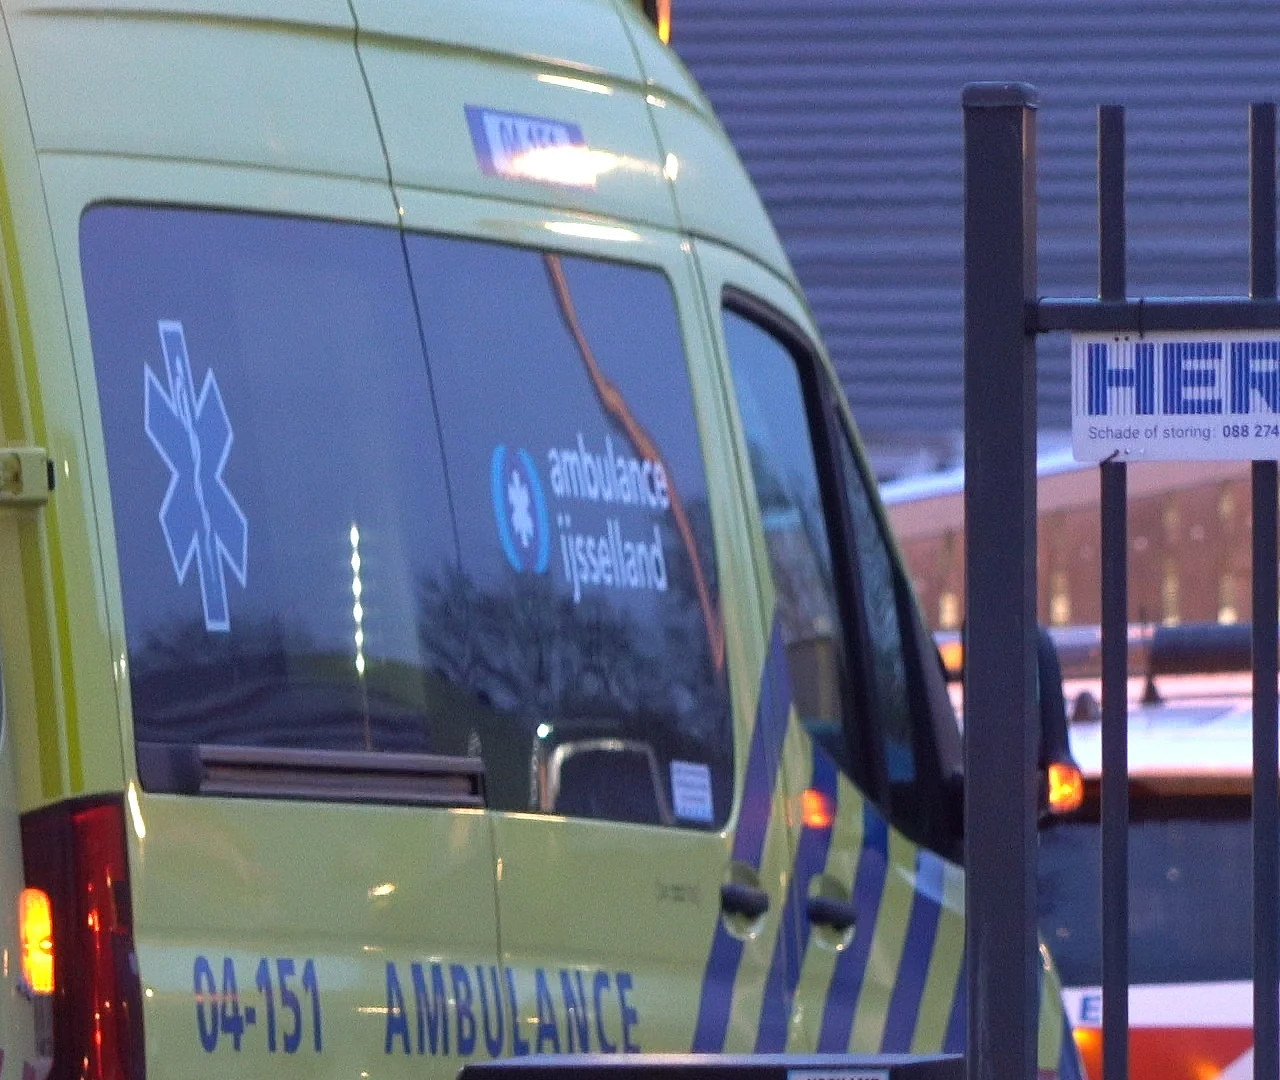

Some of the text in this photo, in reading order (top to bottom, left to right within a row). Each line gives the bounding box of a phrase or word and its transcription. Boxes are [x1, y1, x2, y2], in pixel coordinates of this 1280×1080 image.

[547, 432, 670, 509] ambulance
[1088, 423, 1140, 440] Schade
[1144, 423, 1159, 440] of
[1162, 423, 1216, 444] storing:
[1222, 423, 1250, 438] 088
[1253, 423, 1280, 438] 274
[556, 512, 669, 604] ijsselland
[192, 955, 642, 1057] 04-151 AMBULANCE
